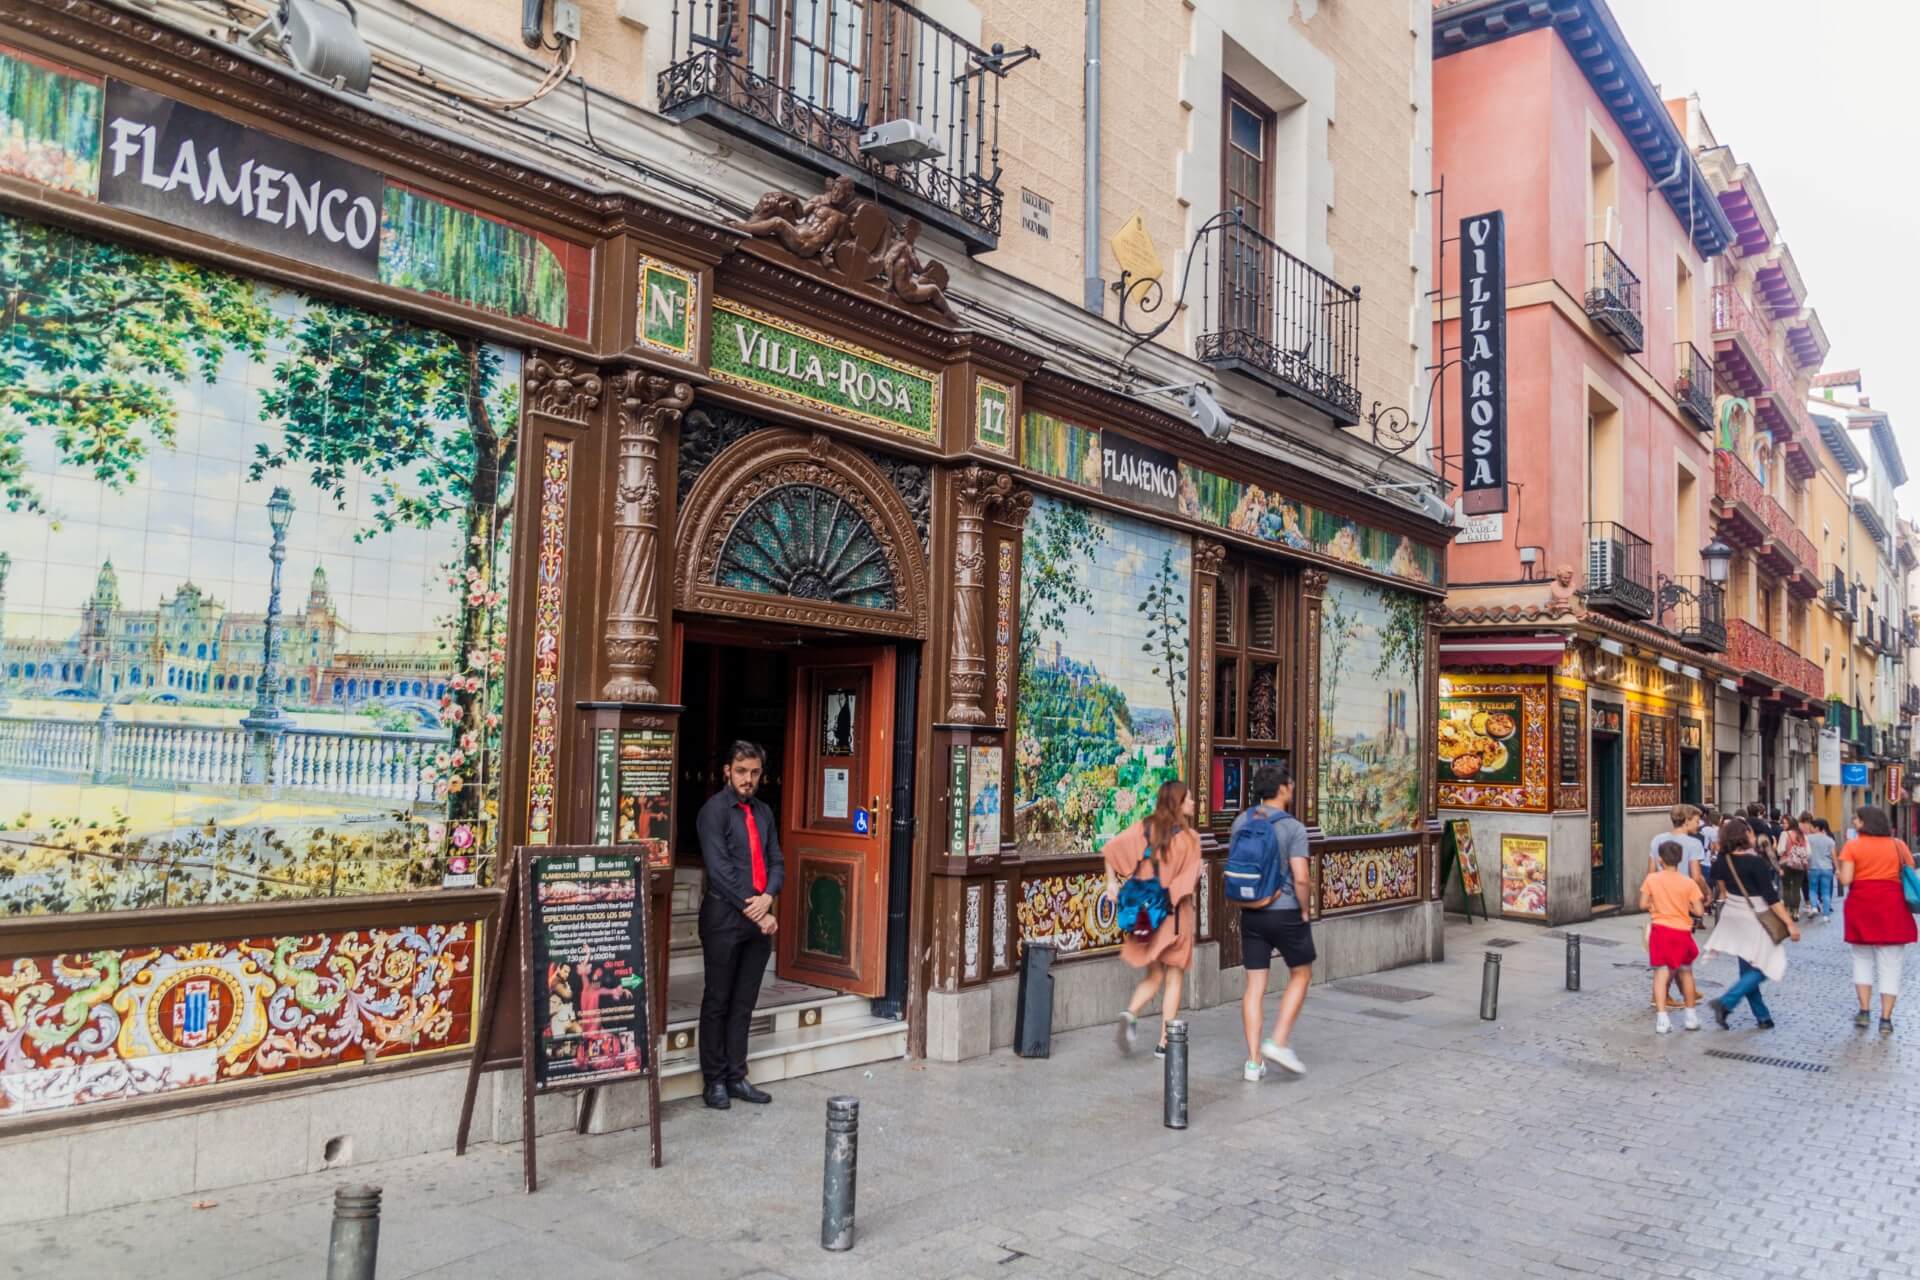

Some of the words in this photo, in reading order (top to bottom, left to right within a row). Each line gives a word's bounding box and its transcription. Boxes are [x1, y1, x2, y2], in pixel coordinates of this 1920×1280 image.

[109, 117, 377, 250] FLAMENCO
[1469, 218, 1493, 362] VILLA
[735, 322, 913, 414] VILLA-ROSA
[982, 397, 1005, 434] 17
[1470, 370, 1495, 486] ROSA
[1103, 448, 1177, 499] FLAMENCO
[954, 765, 963, 850] FLAMENCO
[541, 872, 570, 880] FLAMENCO
[598, 861, 614, 869] desde
[604, 870, 631, 878] FLAMENCO
[543, 914, 585, 923] ESPECTÁCULOS
[585, 912, 605, 920] TODOS
